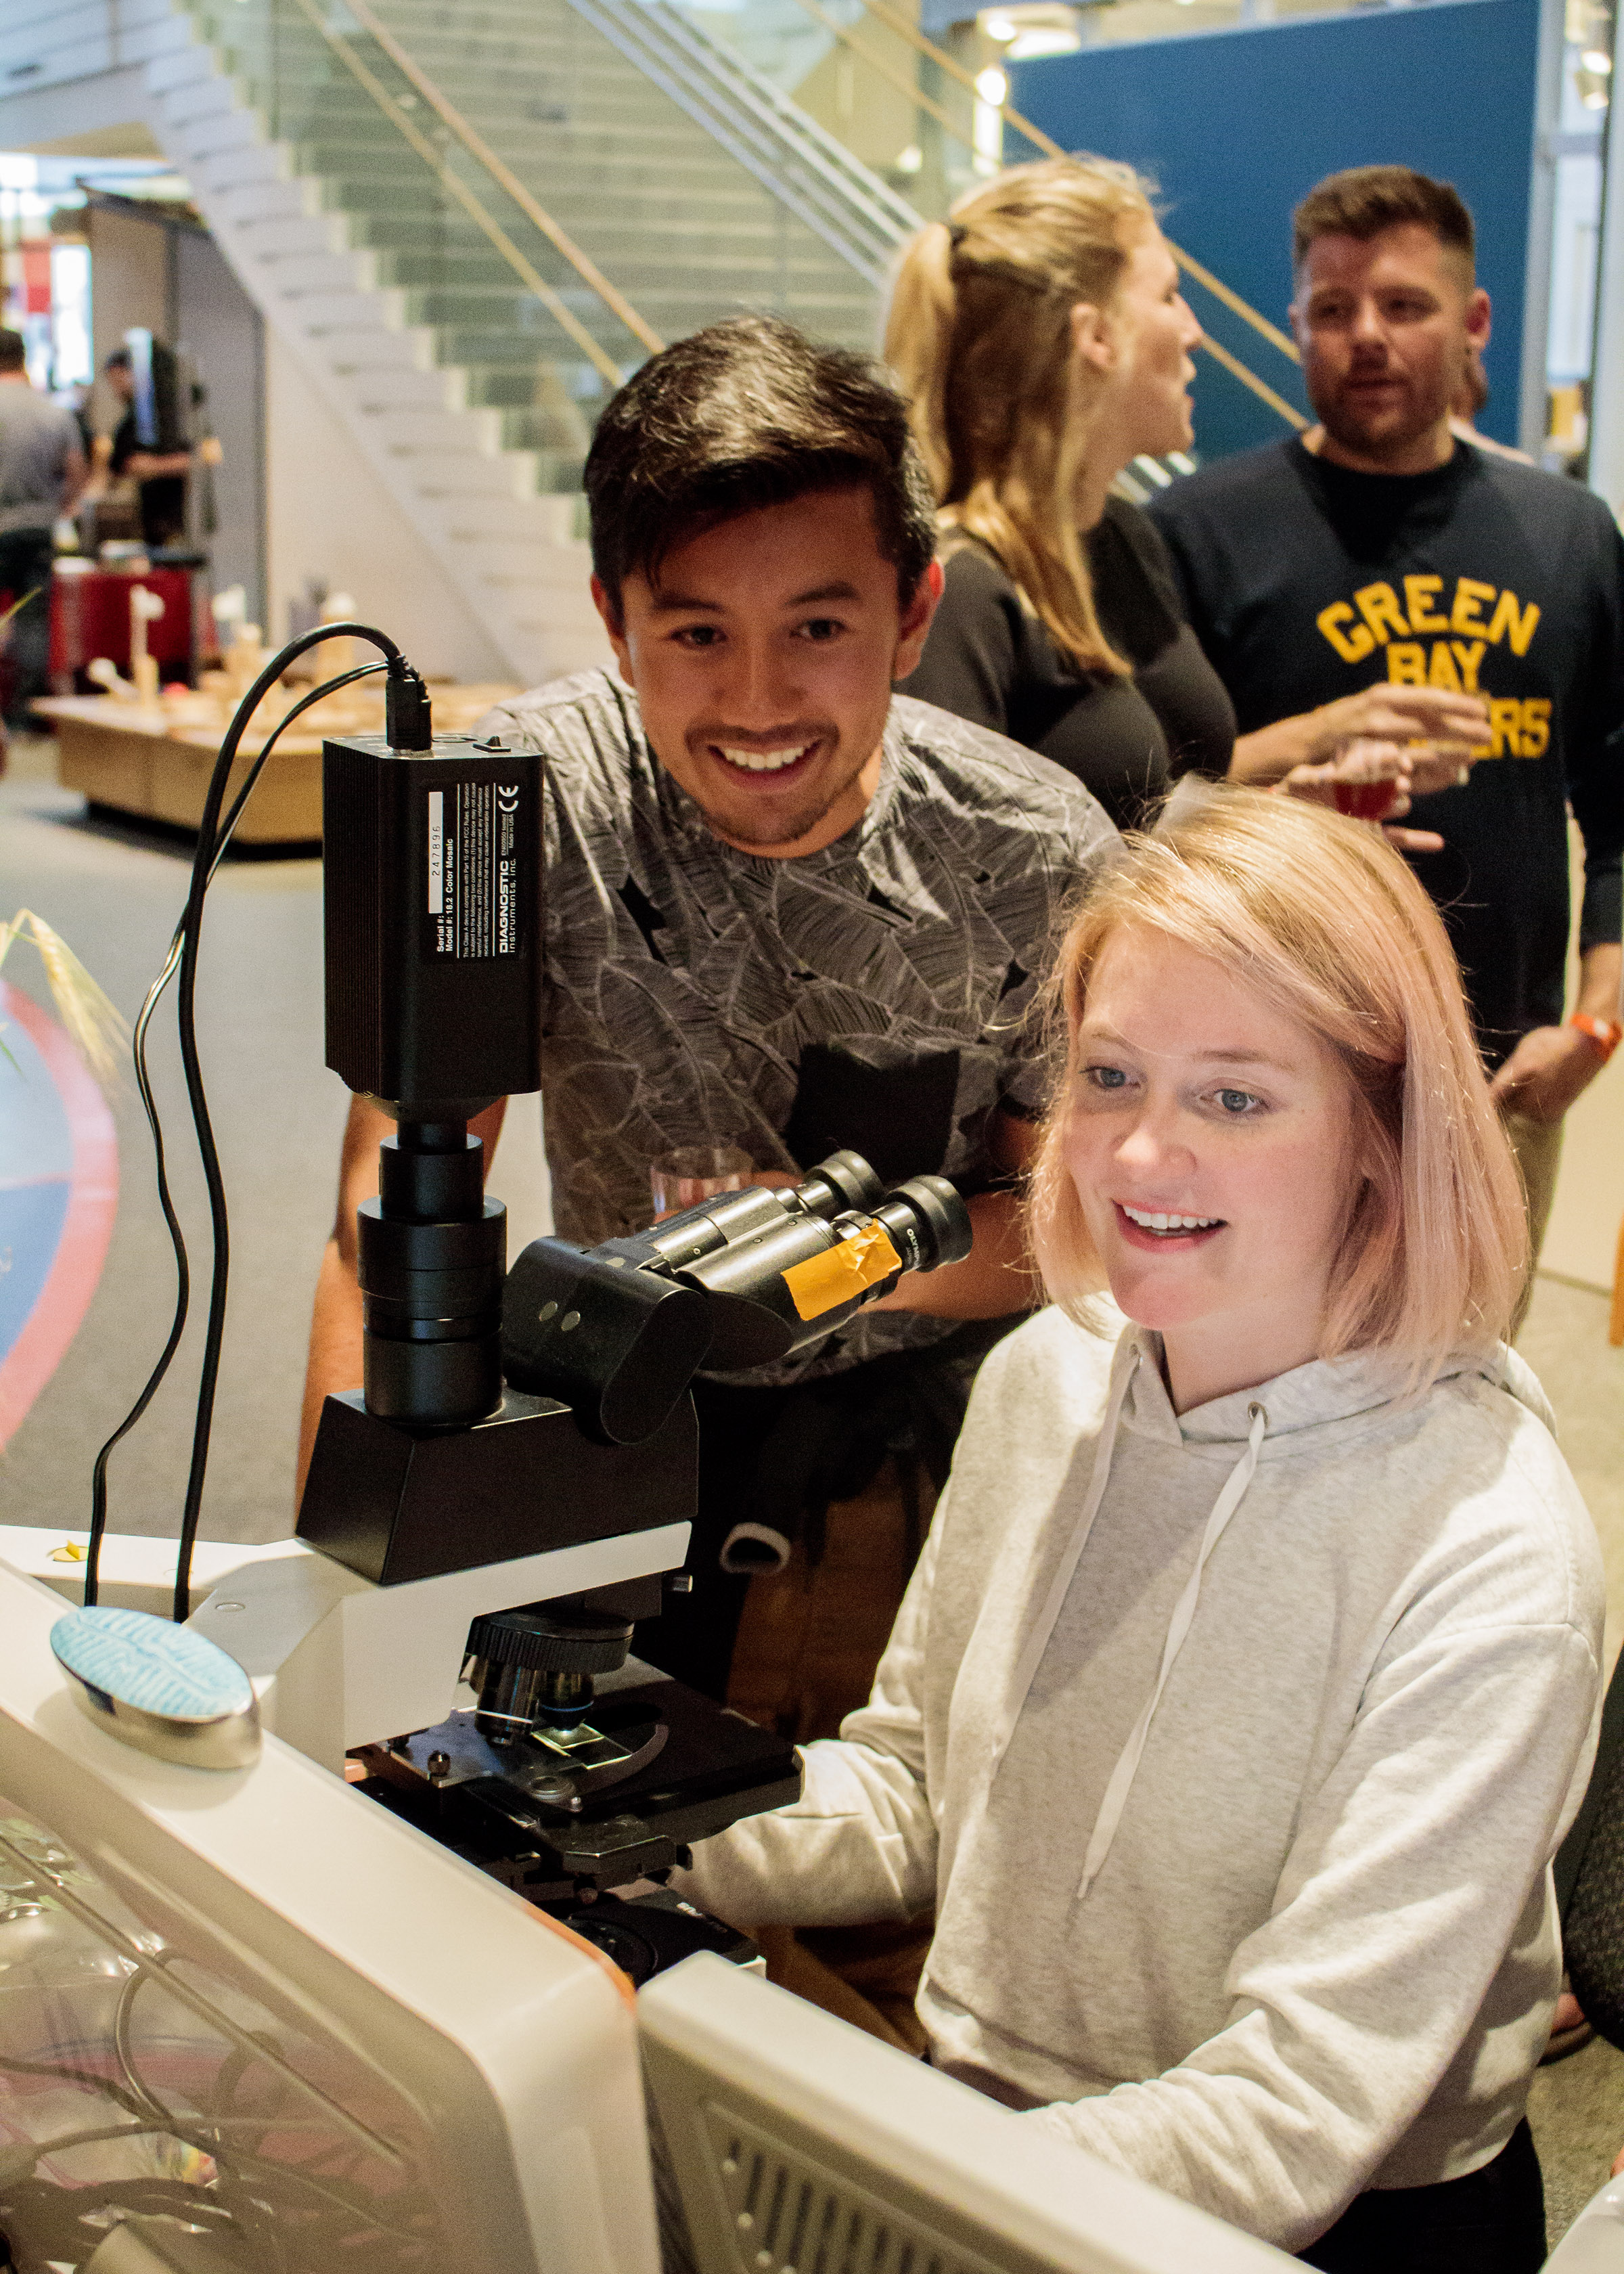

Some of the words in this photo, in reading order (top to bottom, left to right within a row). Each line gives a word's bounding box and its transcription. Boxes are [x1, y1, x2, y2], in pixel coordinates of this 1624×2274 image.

[1317, 574, 1541, 664] GREEN
[1386, 641, 1487, 692] BAY
[432, 826, 441, 876] 247896
[499, 860, 508, 953] DIAGNOSTIC
[508, 880, 516, 952] instruments,
